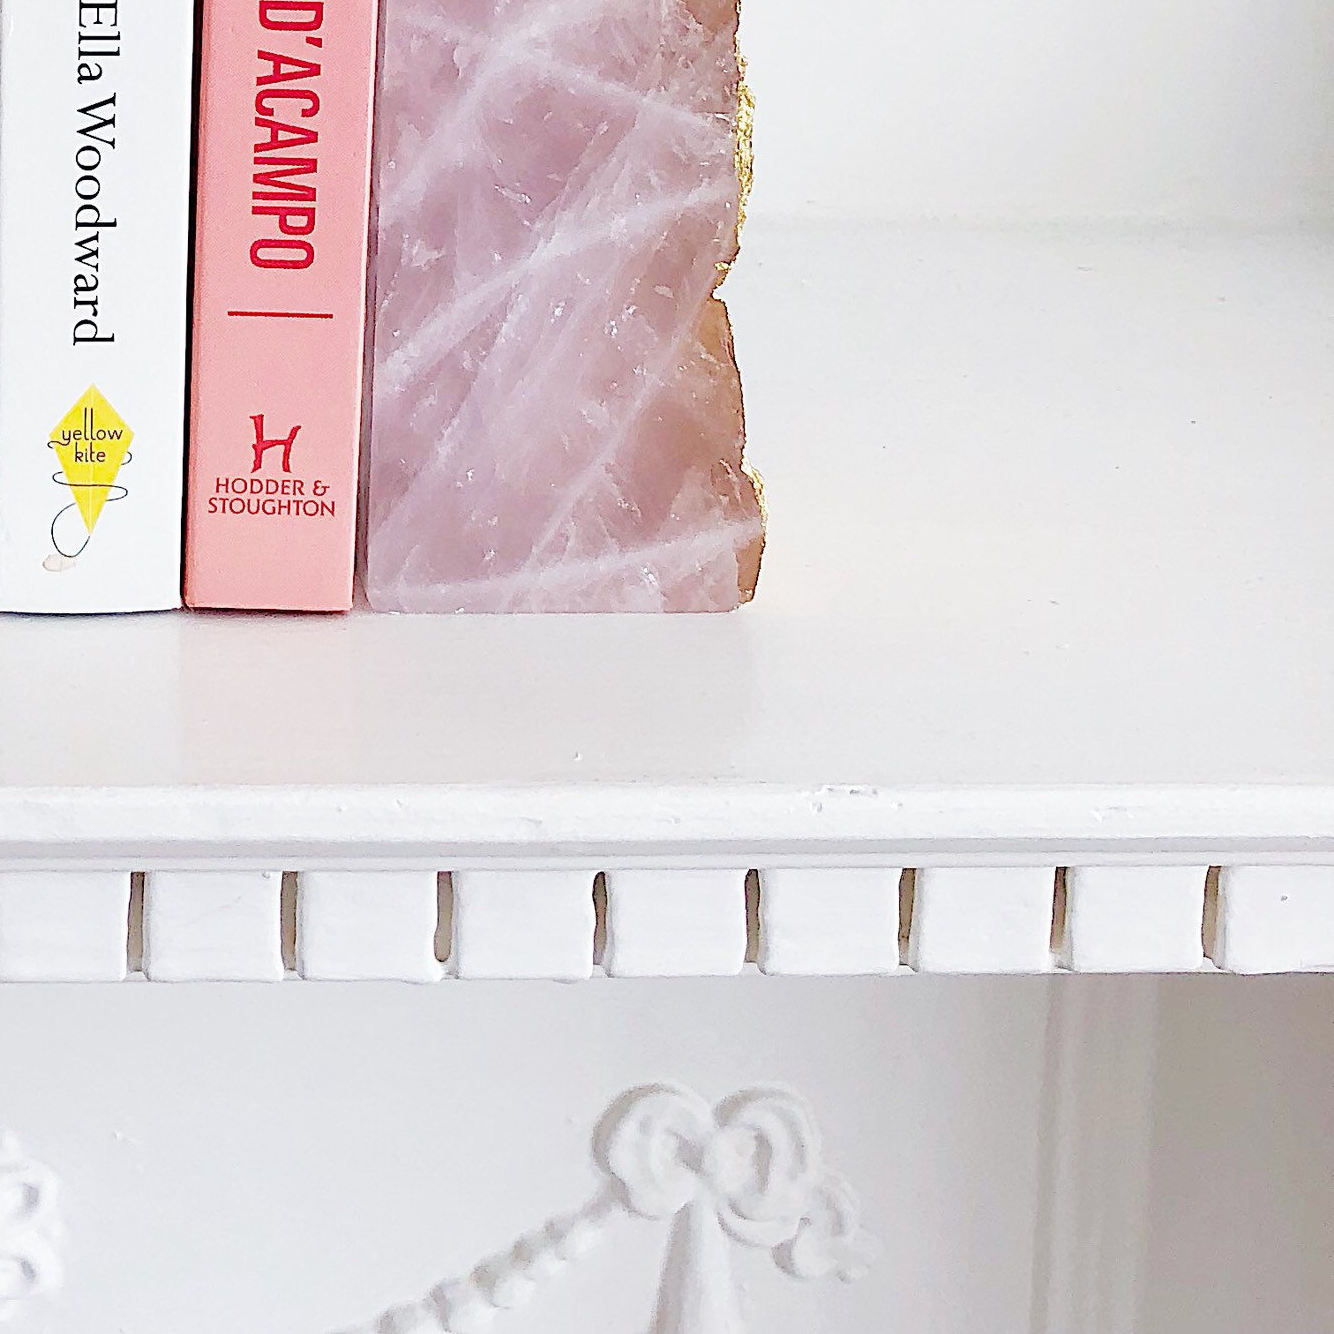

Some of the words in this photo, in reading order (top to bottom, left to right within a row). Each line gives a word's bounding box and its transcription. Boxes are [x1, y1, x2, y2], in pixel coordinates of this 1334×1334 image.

[77, 0, 120, 84] Ella
[250, 0, 324, 269] D'ACAMPO
[73, 93, 117, 345] Woodward
[50, 407, 123, 447] yellow
[74, 441, 106, 463] kite
[208, 497, 335, 516] STOUGHTON
[216, 478, 304, 495] HODDER
[313, 480, 330, 496] &
